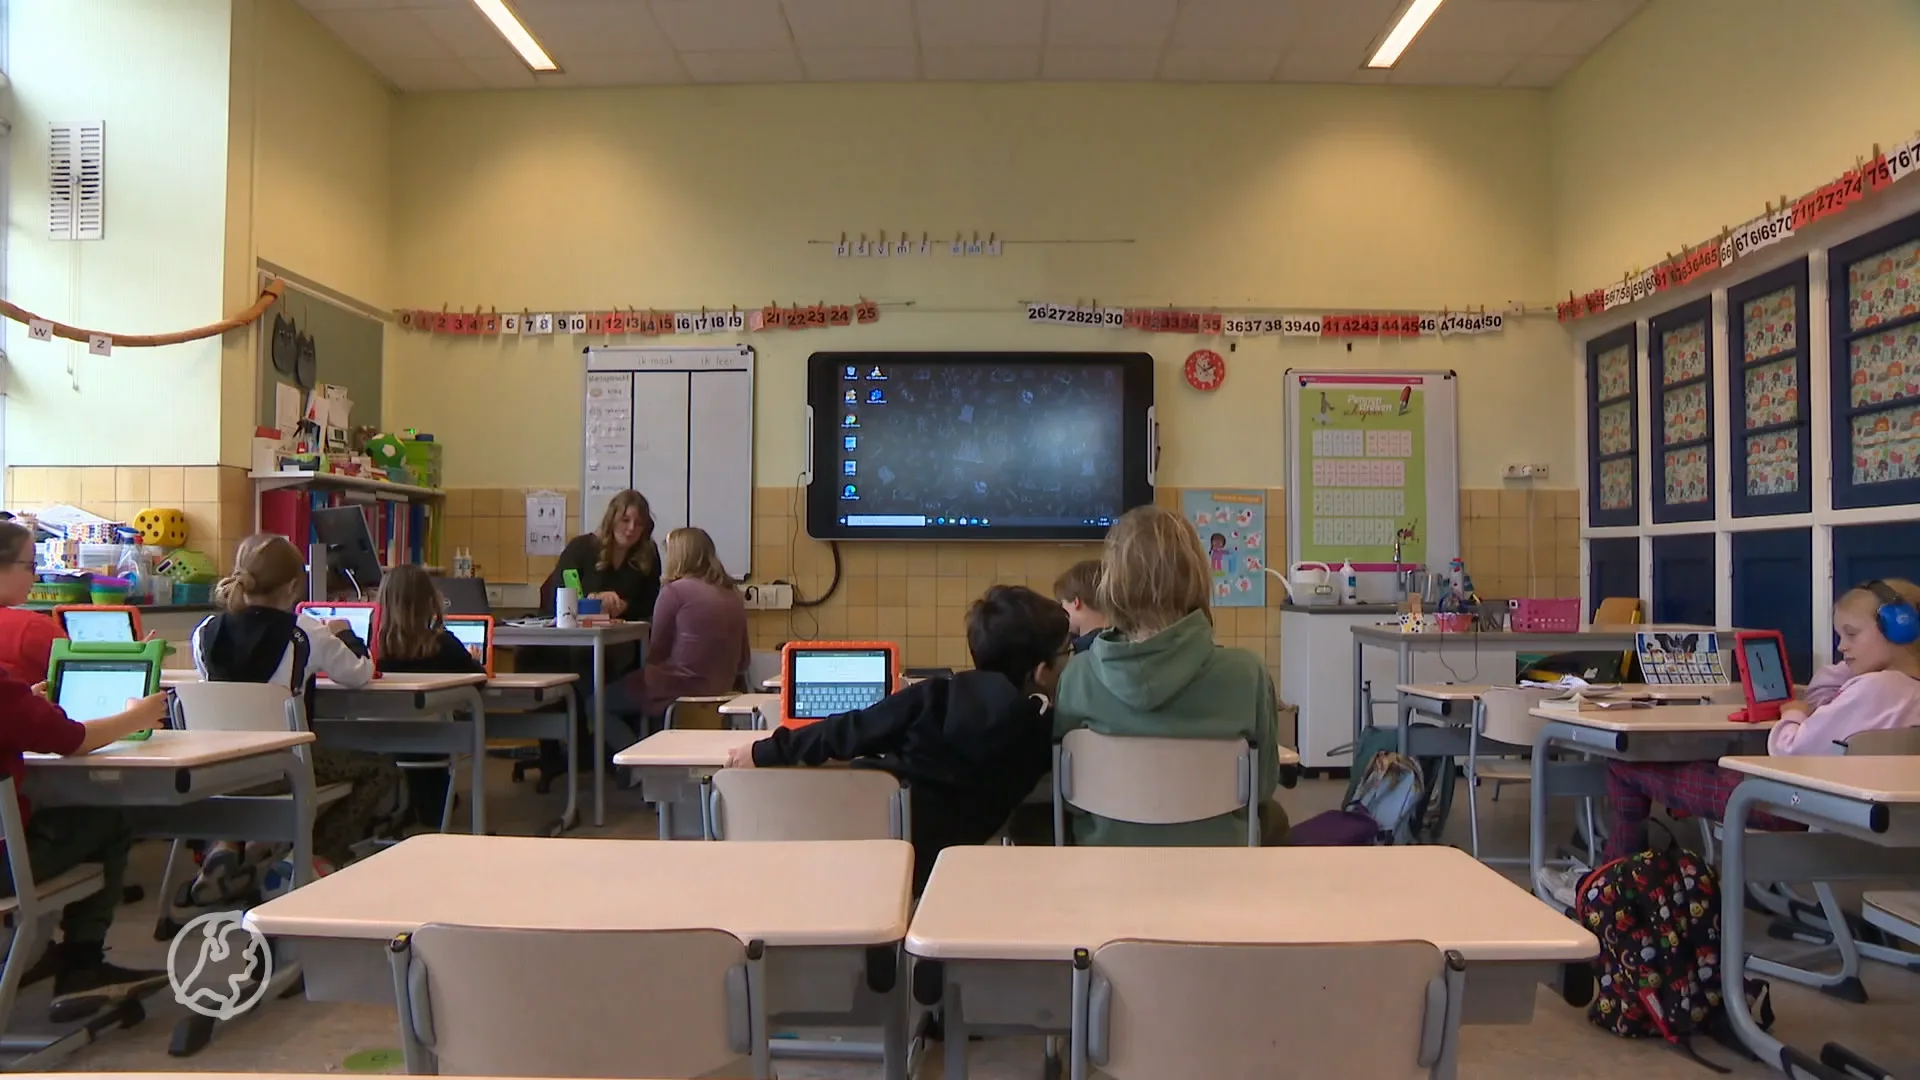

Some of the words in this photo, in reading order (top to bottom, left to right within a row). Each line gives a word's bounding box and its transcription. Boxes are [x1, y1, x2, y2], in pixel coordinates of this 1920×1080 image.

[1604, 291, 1613, 305] 56
[1620, 286, 1631, 299] 58
[1633, 282, 1643, 296] 59
[1655, 272, 1667, 286] 61
[1705, 249, 1717, 265] 65
[1721, 244, 1731, 261] 66
[1735, 233, 1748, 252] 67
[1761, 223, 1776, 240] 69
[1776, 215, 1792, 233] 70
[1792, 204, 1805, 225] 71
[1825, 189, 1843, 209] 73
[1844, 176, 1862, 197] 74
[1868, 163, 1889, 185] 75
[1888, 150, 1910, 175] 76
[897, 245, 907, 254] m
[402, 315, 411, 326] 0
[437, 317, 446, 328] 2
[455, 318, 463, 329] 3
[470, 319, 478, 329] 4
[487, 318, 496, 330] 5
[506, 318, 515, 329] 6
[524, 320, 533, 332] 7
[540, 318, 549, 329] 8
[558, 319, 567, 330] 9
[571, 318, 584, 330] 10
[588, 318, 600, 330] 11
[606, 317, 622, 329] 12
[626, 317, 639, 328] 13
[643, 321, 655, 332] 14
[659, 318, 672, 329] 15
[677, 318, 690, 329] 16
[695, 319, 708, 331] 17
[711, 316, 725, 328] 18
[729, 316, 742, 328] 19
[767, 312, 780, 323] 21
[788, 315, 805, 326] 22
[808, 311, 825, 323] 23
[830, 310, 848, 321] 24
[858, 307, 876, 320] 25
[1028, 307, 1046, 319] 26
[1048, 308, 1067, 320] 27
[1067, 310, 1085, 323] 28
[1085, 312, 1102, 324] 29
[1105, 312, 1123, 324] 30
[1202, 318, 1220, 330] 35
[1226, 320, 1243, 332] 36
[1244, 319, 1262, 332] 37
[1265, 319, 1282, 332] 38
[1284, 320, 1302, 333] 39
[1302, 320, 1320, 333] 40
[1323, 320, 1340, 333] 41
[1342, 320, 1360, 333] 42
[1360, 320, 1379, 333] 43
[1381, 320, 1399, 332] 44
[1401, 320, 1418, 333] 45
[1418, 319, 1435, 332] 46
[1440, 316, 1456, 332] 47
[1456, 317, 1473, 330] 48
[1485, 315, 1502, 328] 50
[701, 355, 711, 365] ik
